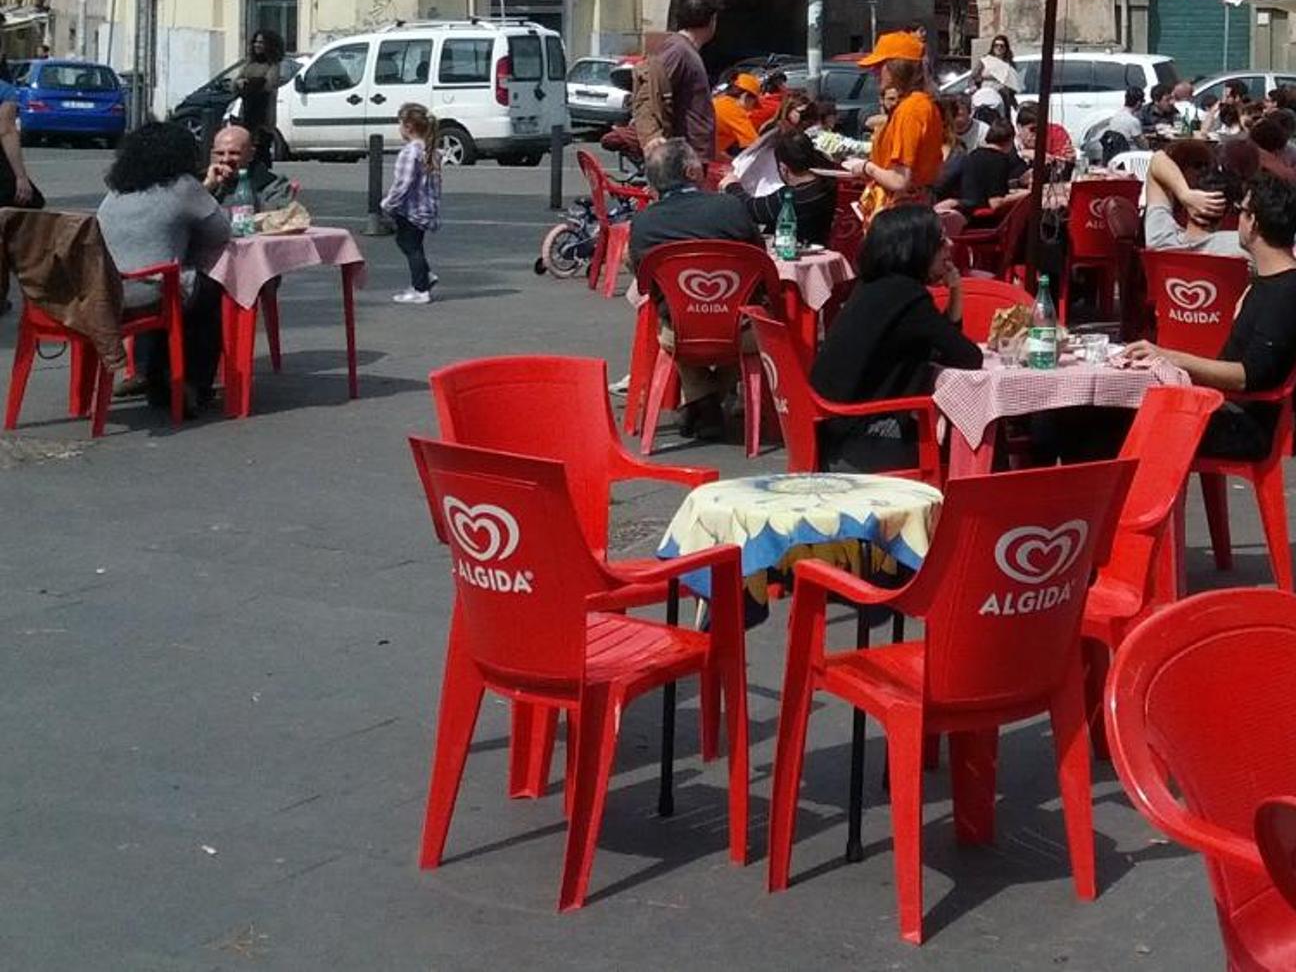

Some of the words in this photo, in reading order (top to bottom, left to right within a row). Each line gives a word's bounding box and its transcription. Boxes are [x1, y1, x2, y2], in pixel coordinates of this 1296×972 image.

[686, 302, 729, 314] ALGIDA
[1168, 308, 1221, 325] ALGIDA
[458, 558, 534, 595] ALGIDA
[977, 581, 1073, 616] ALGIDA
